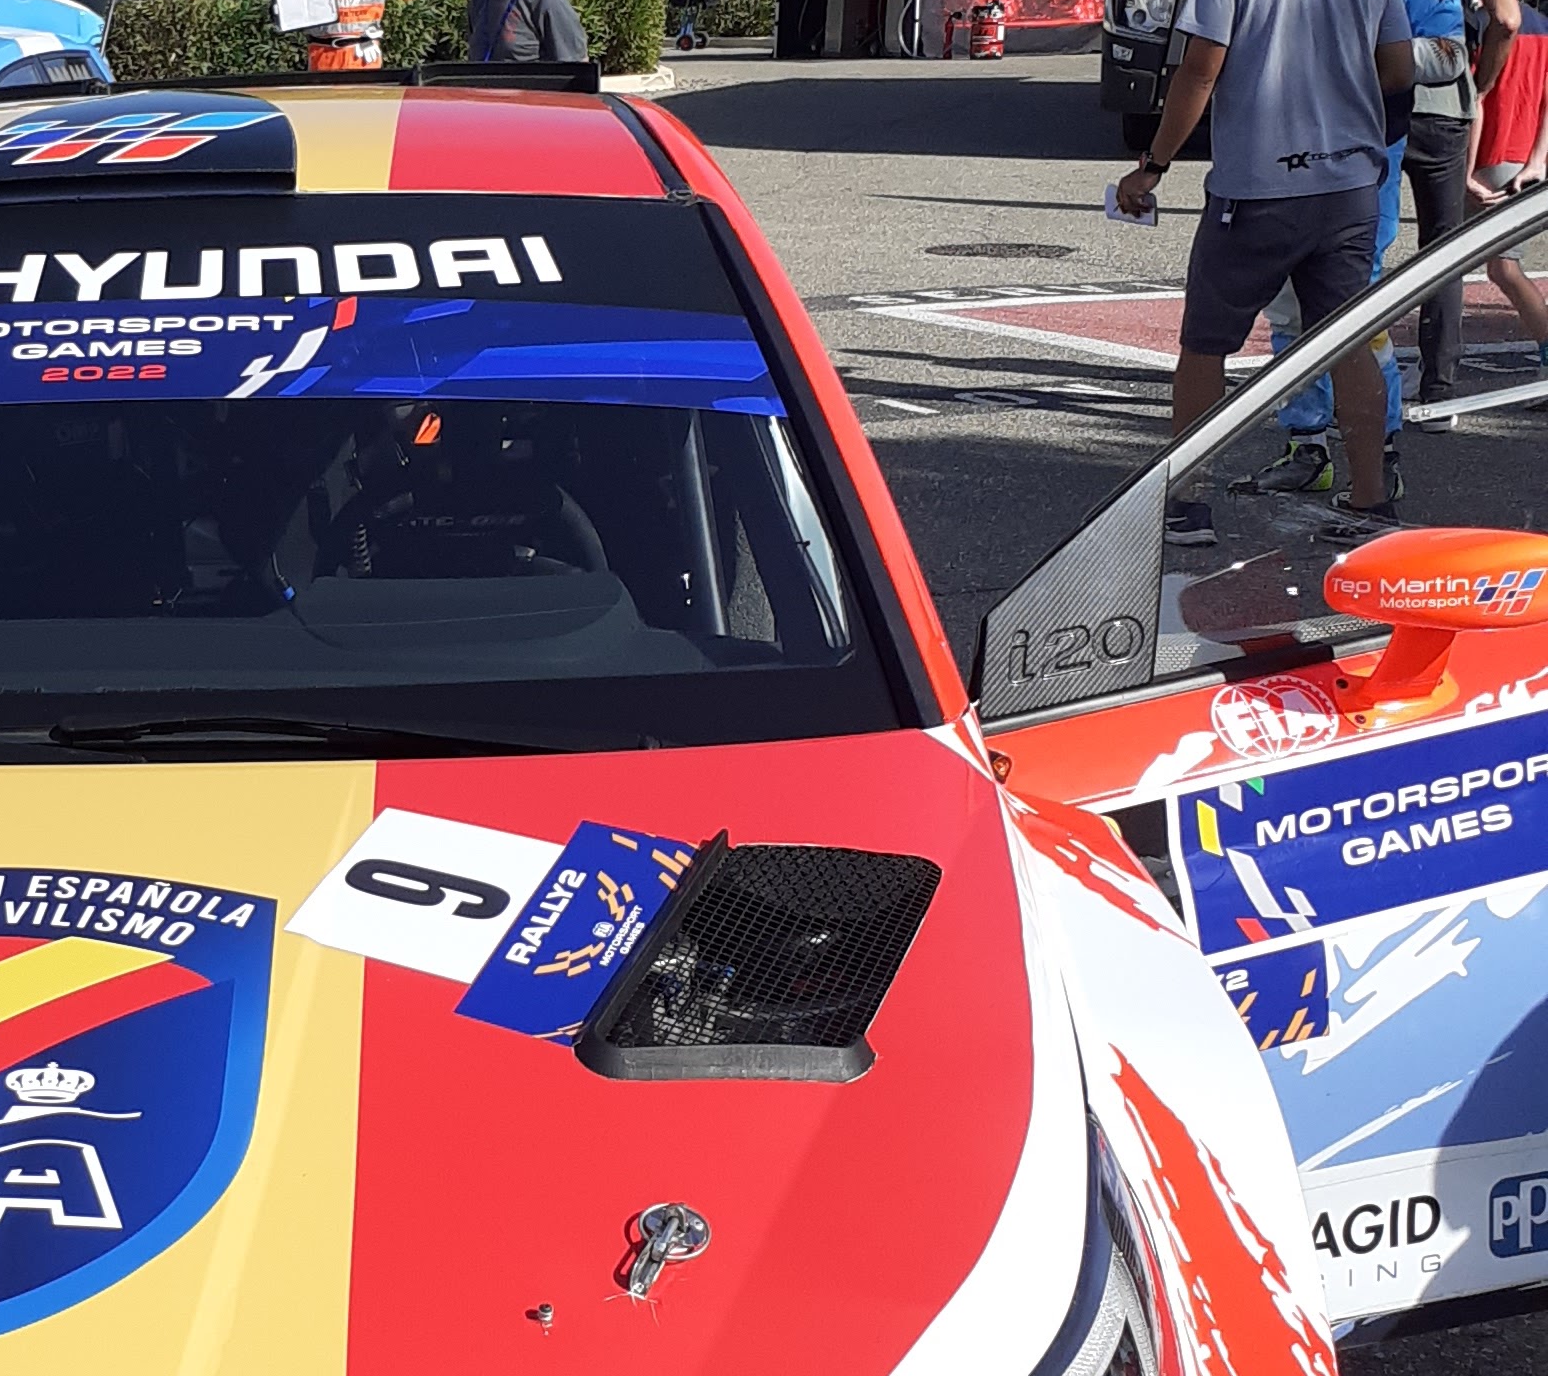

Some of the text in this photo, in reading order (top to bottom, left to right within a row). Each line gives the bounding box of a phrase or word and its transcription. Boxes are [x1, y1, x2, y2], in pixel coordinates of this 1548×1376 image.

[10, 338, 204, 361] GAMES
[40, 364, 168, 382] 2022
[1332, 577, 1372, 594] Teo
[1379, 594, 1471, 610] Motorsport
[1005, 614, 1147, 687] i20
[1255, 753, 1548, 847] MOTORSPOR
[1341, 803, 1513, 867] GAMES
[26, 874, 256, 929] ESPAÑOLA
[344, 858, 511, 920] 9
[505, 867, 587, 967] RALLY2
[599, 904, 644, 966] MOTORSPORT
[619, 921, 646, 955] GAMES
[1311, 1194, 1441, 1259] AGID
